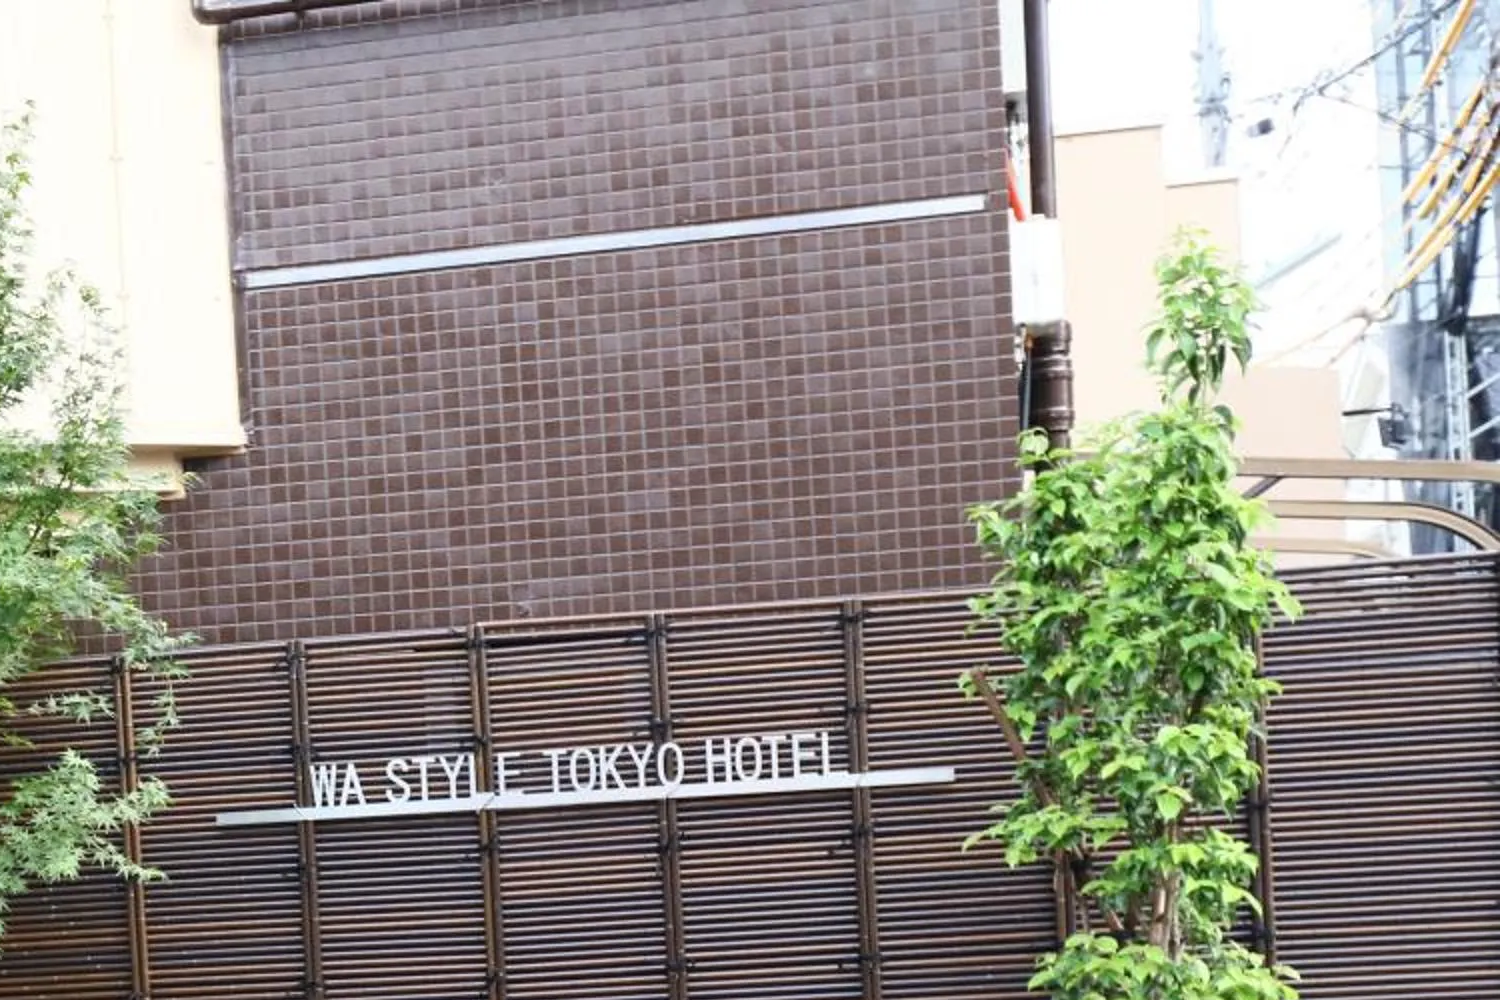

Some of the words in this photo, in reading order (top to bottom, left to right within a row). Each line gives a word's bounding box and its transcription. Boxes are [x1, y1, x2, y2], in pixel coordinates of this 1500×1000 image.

[309, 763, 367, 807] WA
[384, 751, 525, 802] STYLE
[541, 741, 685, 793] TOKYO
[704, 731, 848, 785] HOTEL
